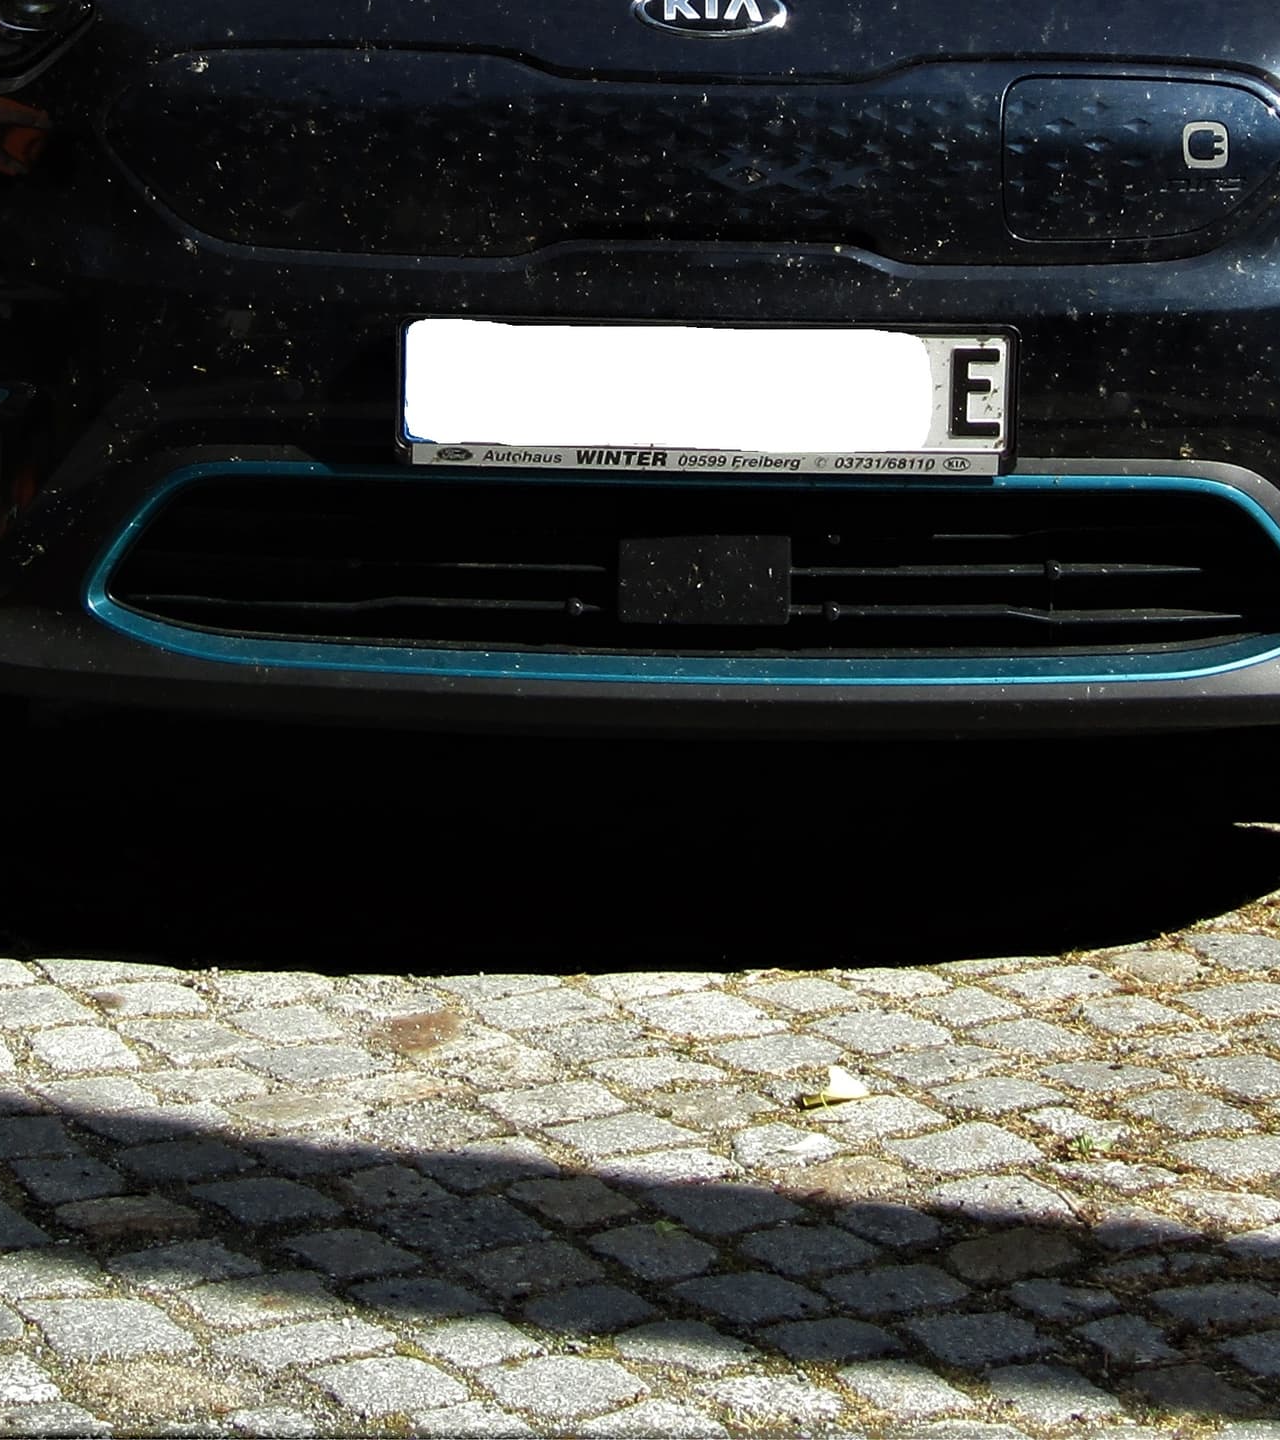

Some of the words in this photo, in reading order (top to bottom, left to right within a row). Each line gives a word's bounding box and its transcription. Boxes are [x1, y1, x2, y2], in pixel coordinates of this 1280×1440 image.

[949, 348, 1001, 439] E
[483, 449, 563, 464] Autohaus
[576, 449, 668, 466] WINTER
[678, 455, 727, 467] 09599
[731, 456, 800, 471] Freiberg
[834, 457, 935, 471] 03731/68110
[946, 459, 967, 470] KIA
